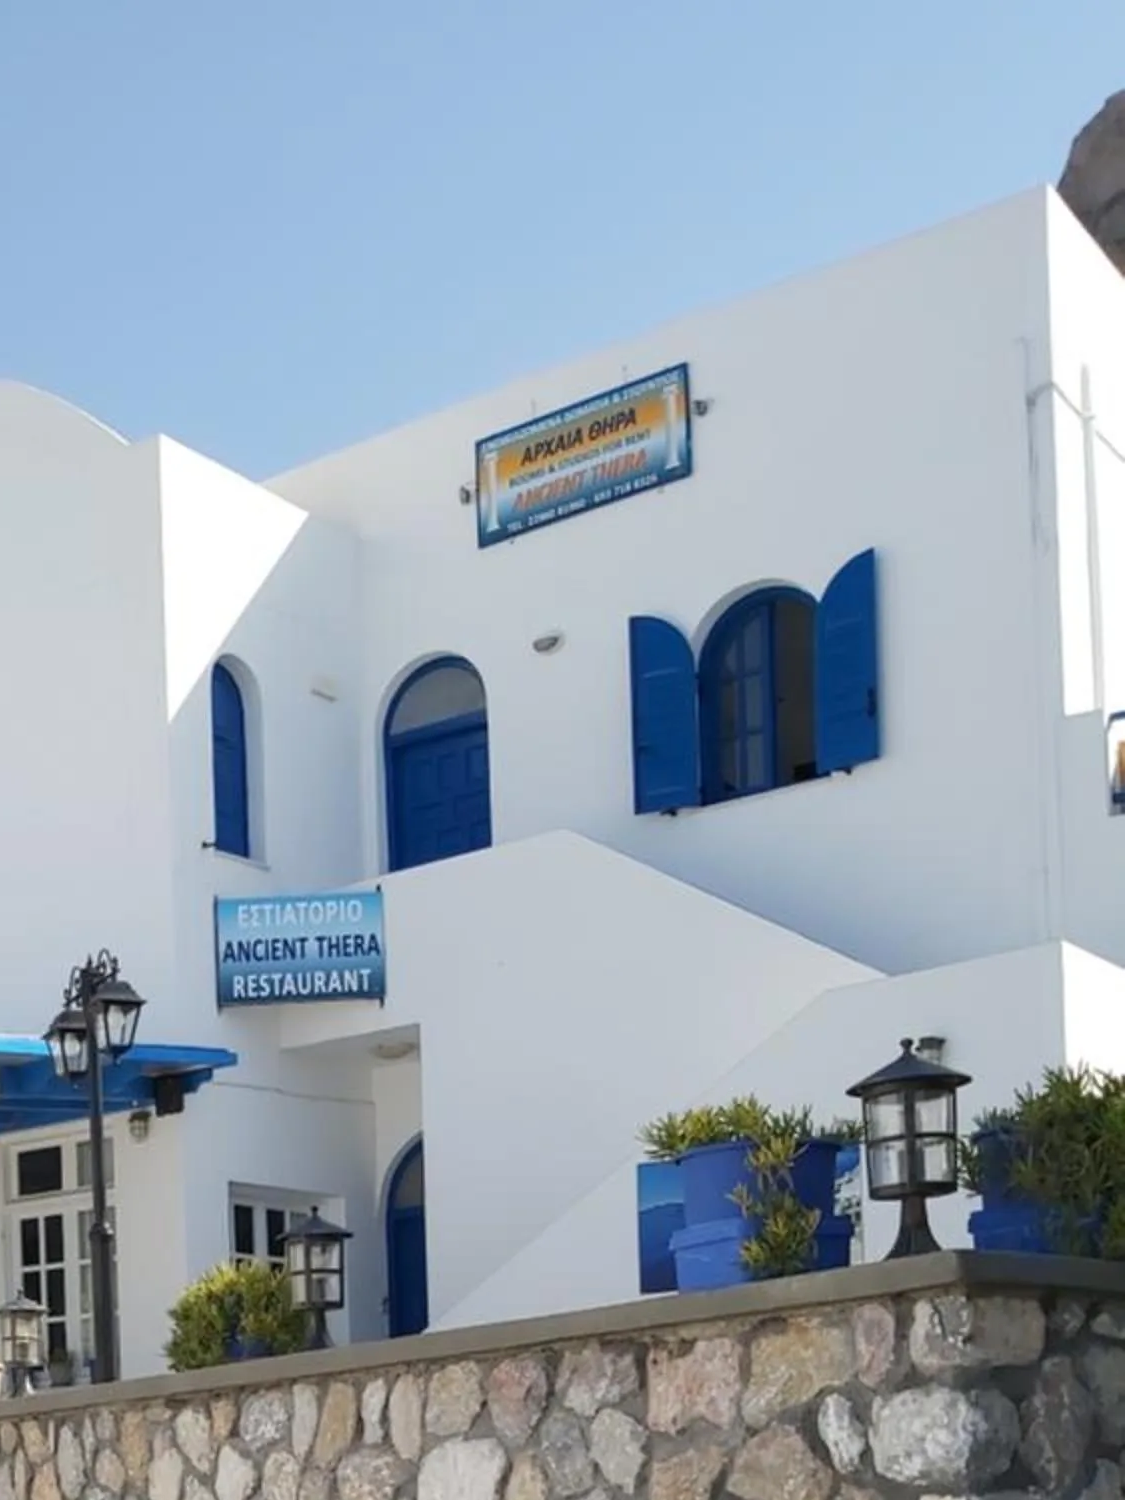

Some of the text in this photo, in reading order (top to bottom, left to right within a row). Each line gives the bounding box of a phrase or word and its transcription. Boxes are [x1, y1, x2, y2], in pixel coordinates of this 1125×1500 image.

[519, 426, 583, 467] ΑΡΧΑΙΑ
[588, 407, 636, 441] ΘΗΡΑ
[512, 468, 587, 513] ANCIENT
[590, 448, 648, 485] THERA
[237, 899, 363, 927] ΕΣΤΙΑΤΟΡΙΟ
[222, 933, 381, 963] ANCIENT THERA
[232, 968, 372, 998] RESTAURANT
